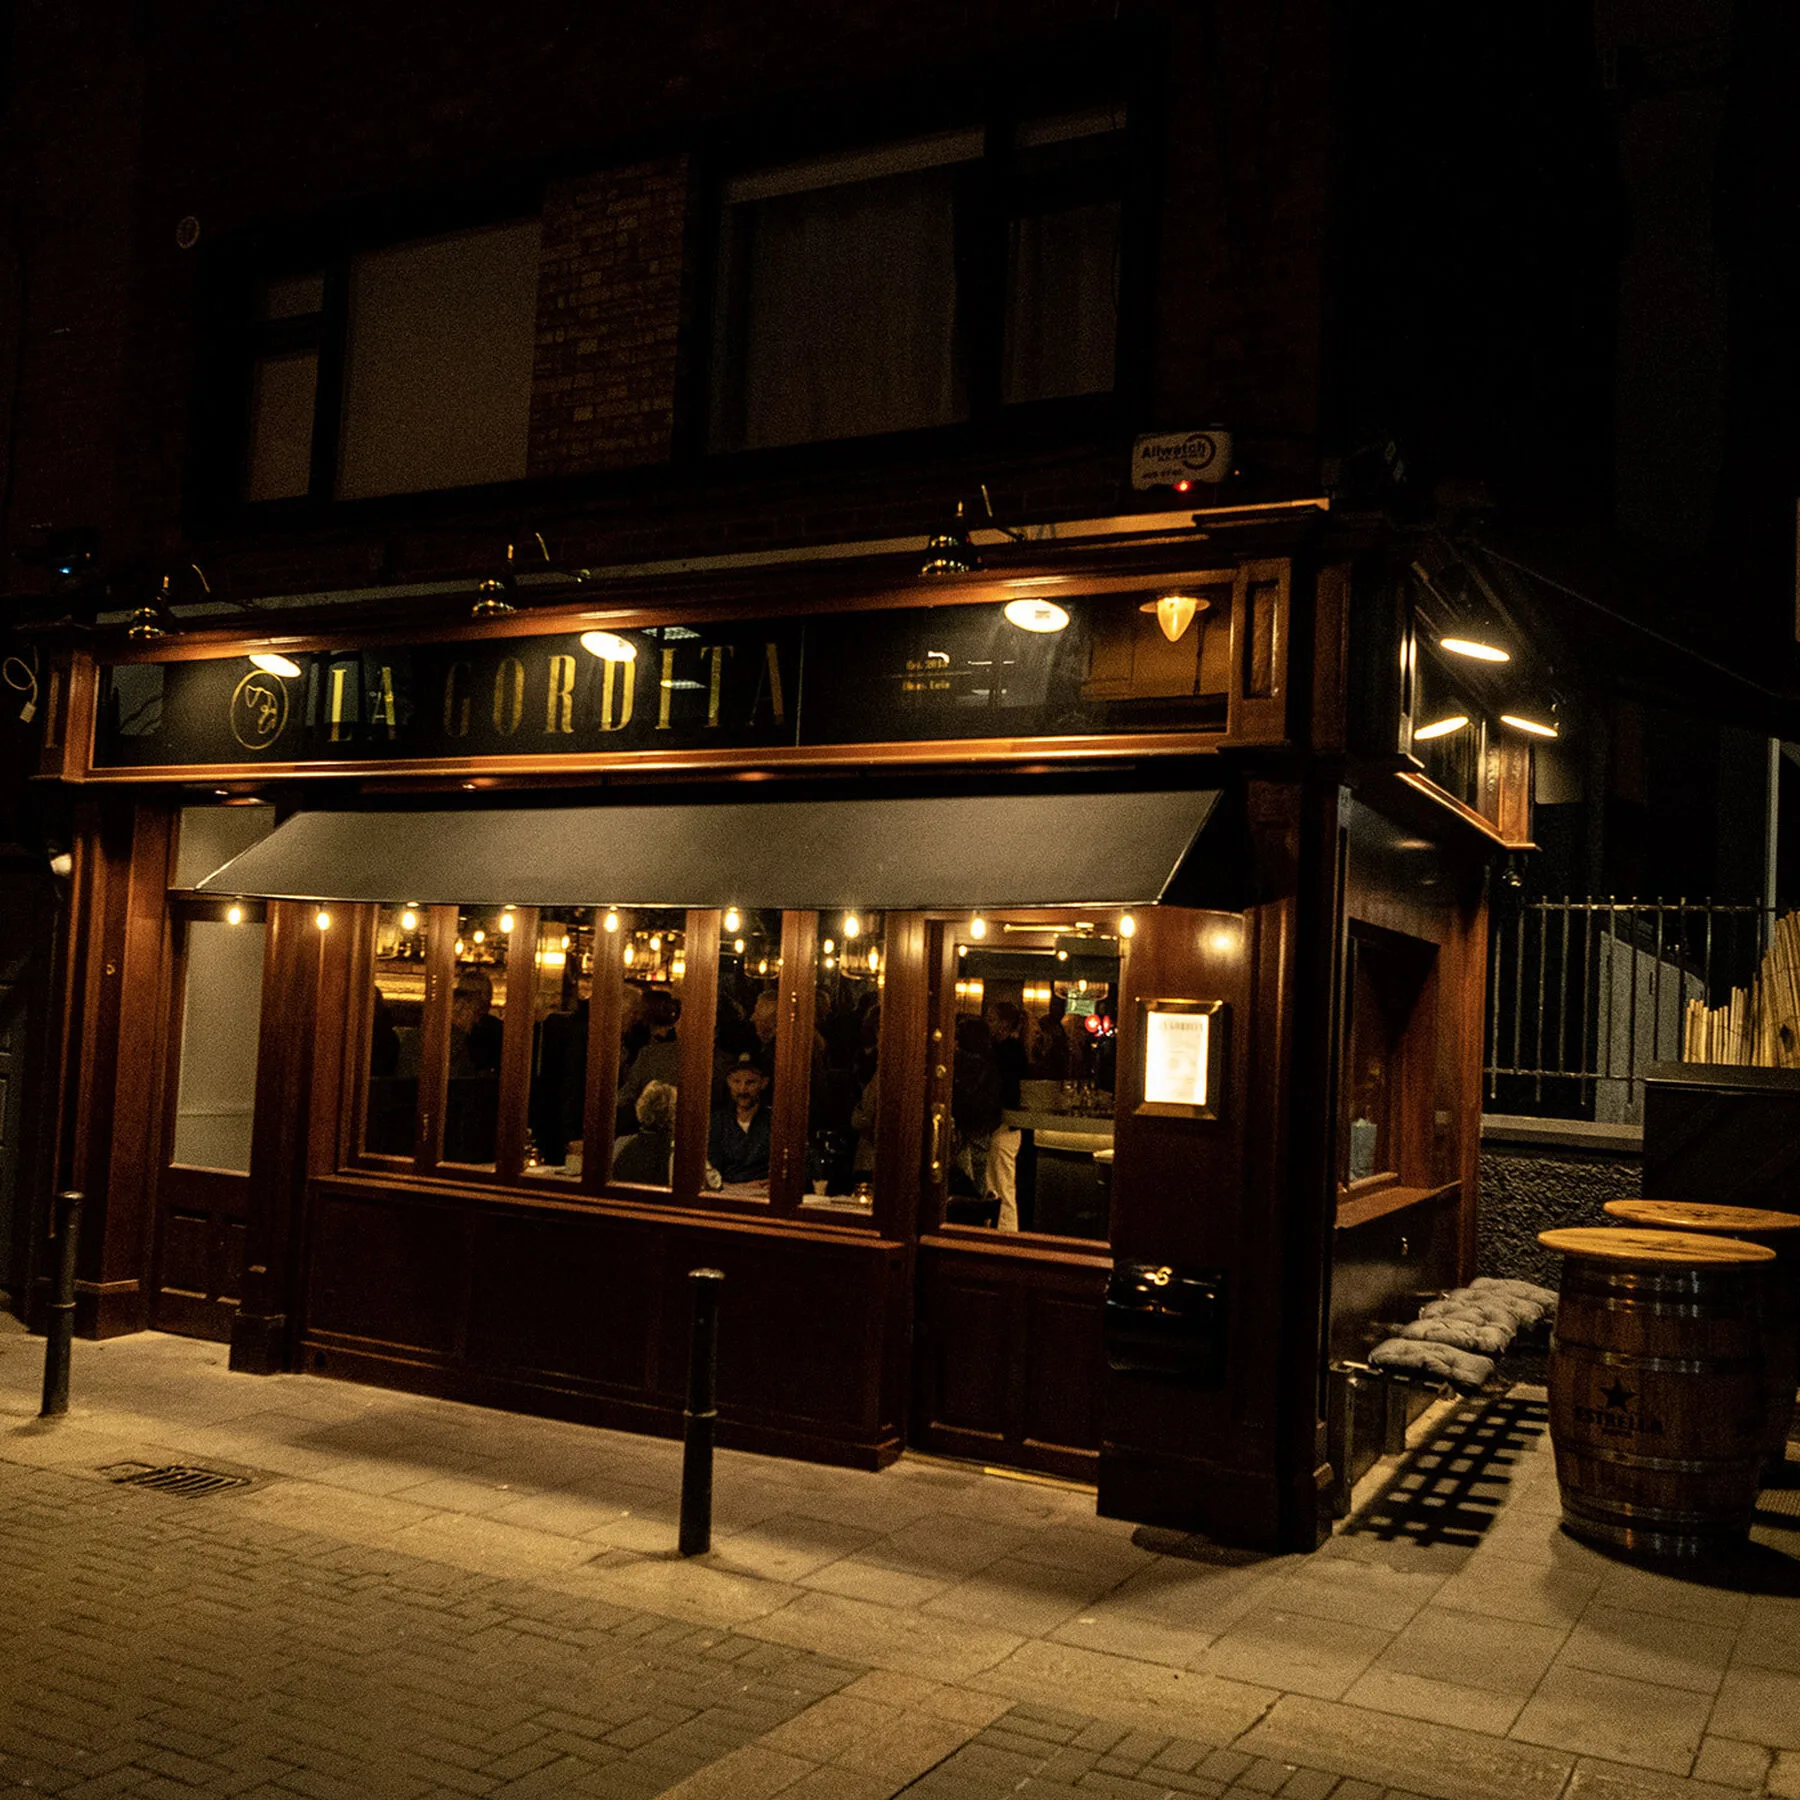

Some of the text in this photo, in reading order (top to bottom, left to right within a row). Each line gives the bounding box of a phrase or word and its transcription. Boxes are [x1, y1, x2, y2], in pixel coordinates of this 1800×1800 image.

[328, 643, 785, 743] LA GORDITA
[1575, 1406, 1663, 1434] ESTRELLA
